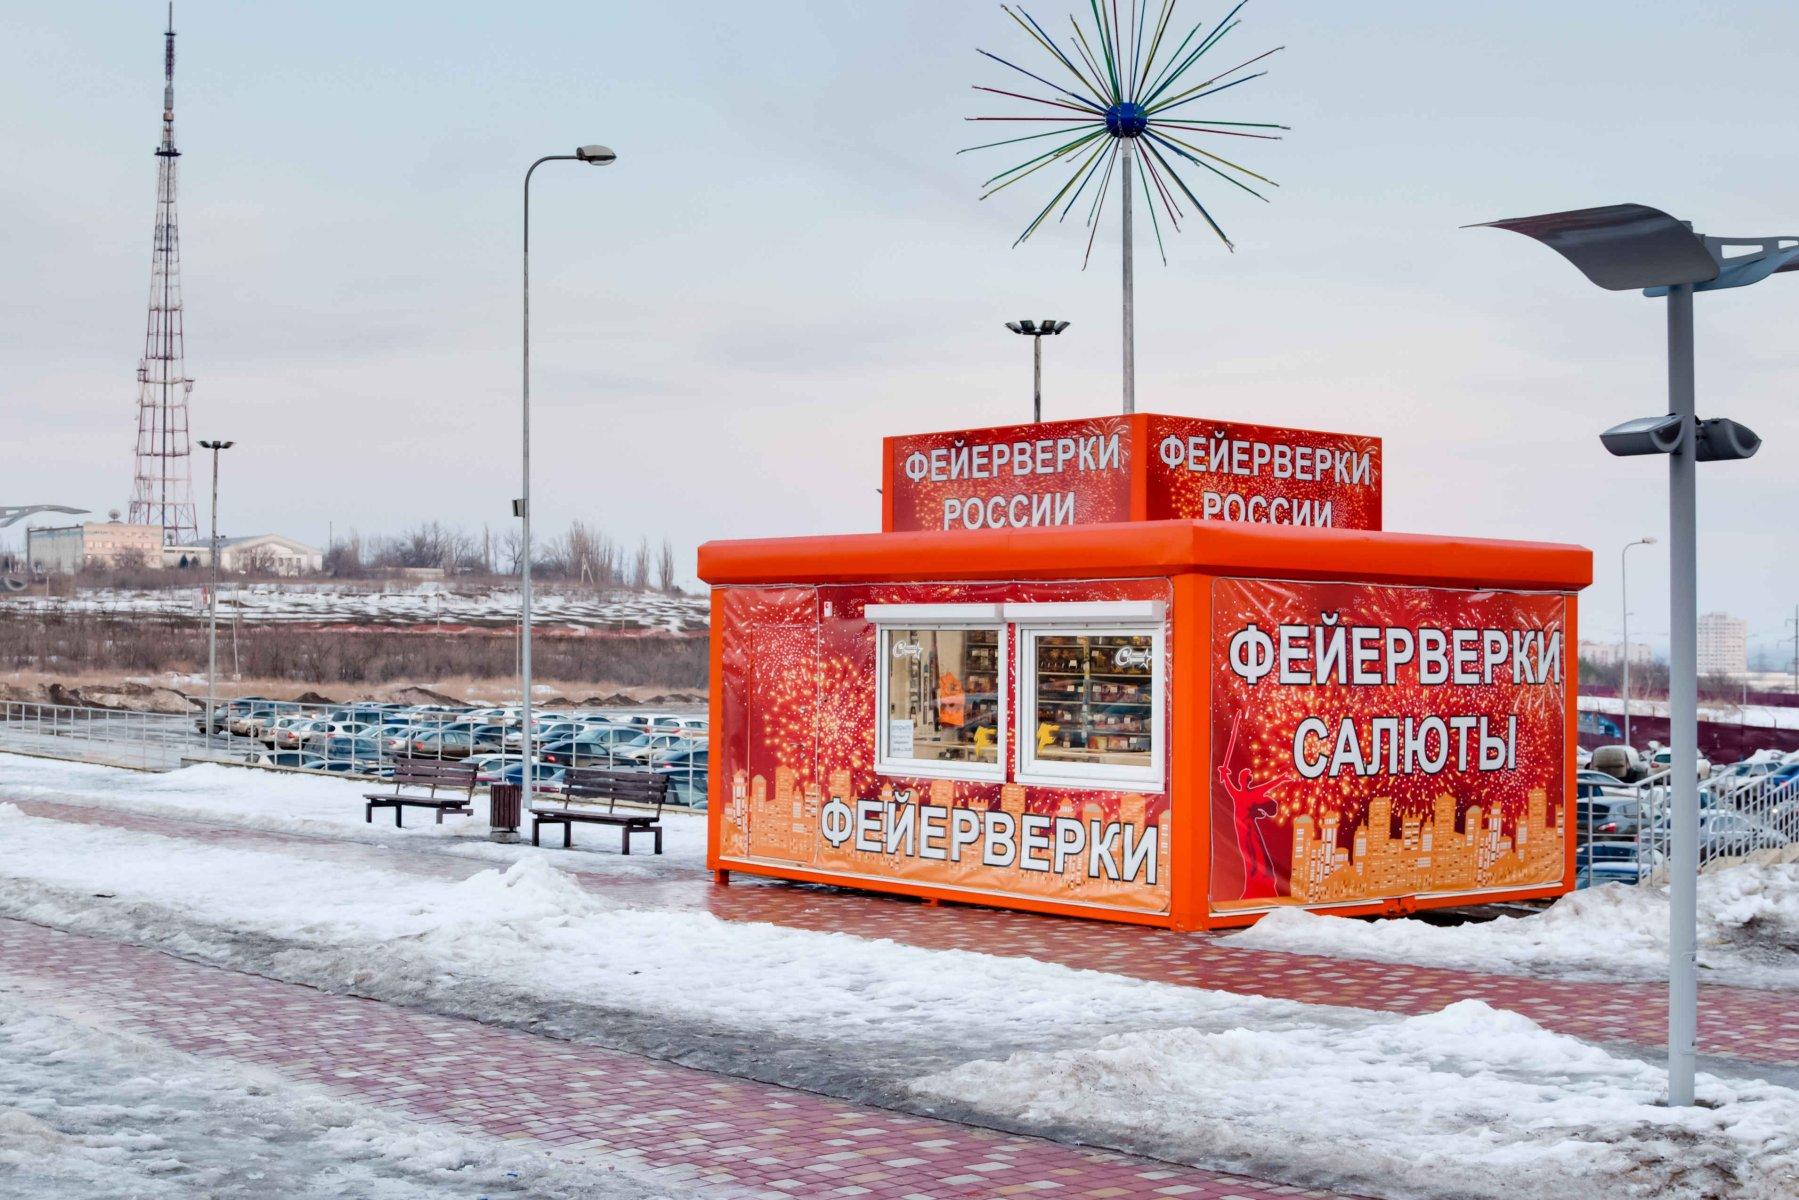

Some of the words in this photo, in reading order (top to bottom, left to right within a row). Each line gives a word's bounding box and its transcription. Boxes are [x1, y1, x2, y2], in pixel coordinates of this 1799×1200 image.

[905, 434, 1119, 482] ФЕЙЕРВЕРКИ
[1159, 430, 1371, 486] ФЕЙЕРВЕРКИ
[943, 491, 1075, 531] РОССИИ
[1203, 491, 1332, 528] РОССИИ
[1229, 612, 1560, 685] ФЕЙЕРВЕРКИ
[1293, 715, 1517, 779] САЛЮТЫ
[821, 790, 1157, 885] ФЕЙЕРВЕРКИ
